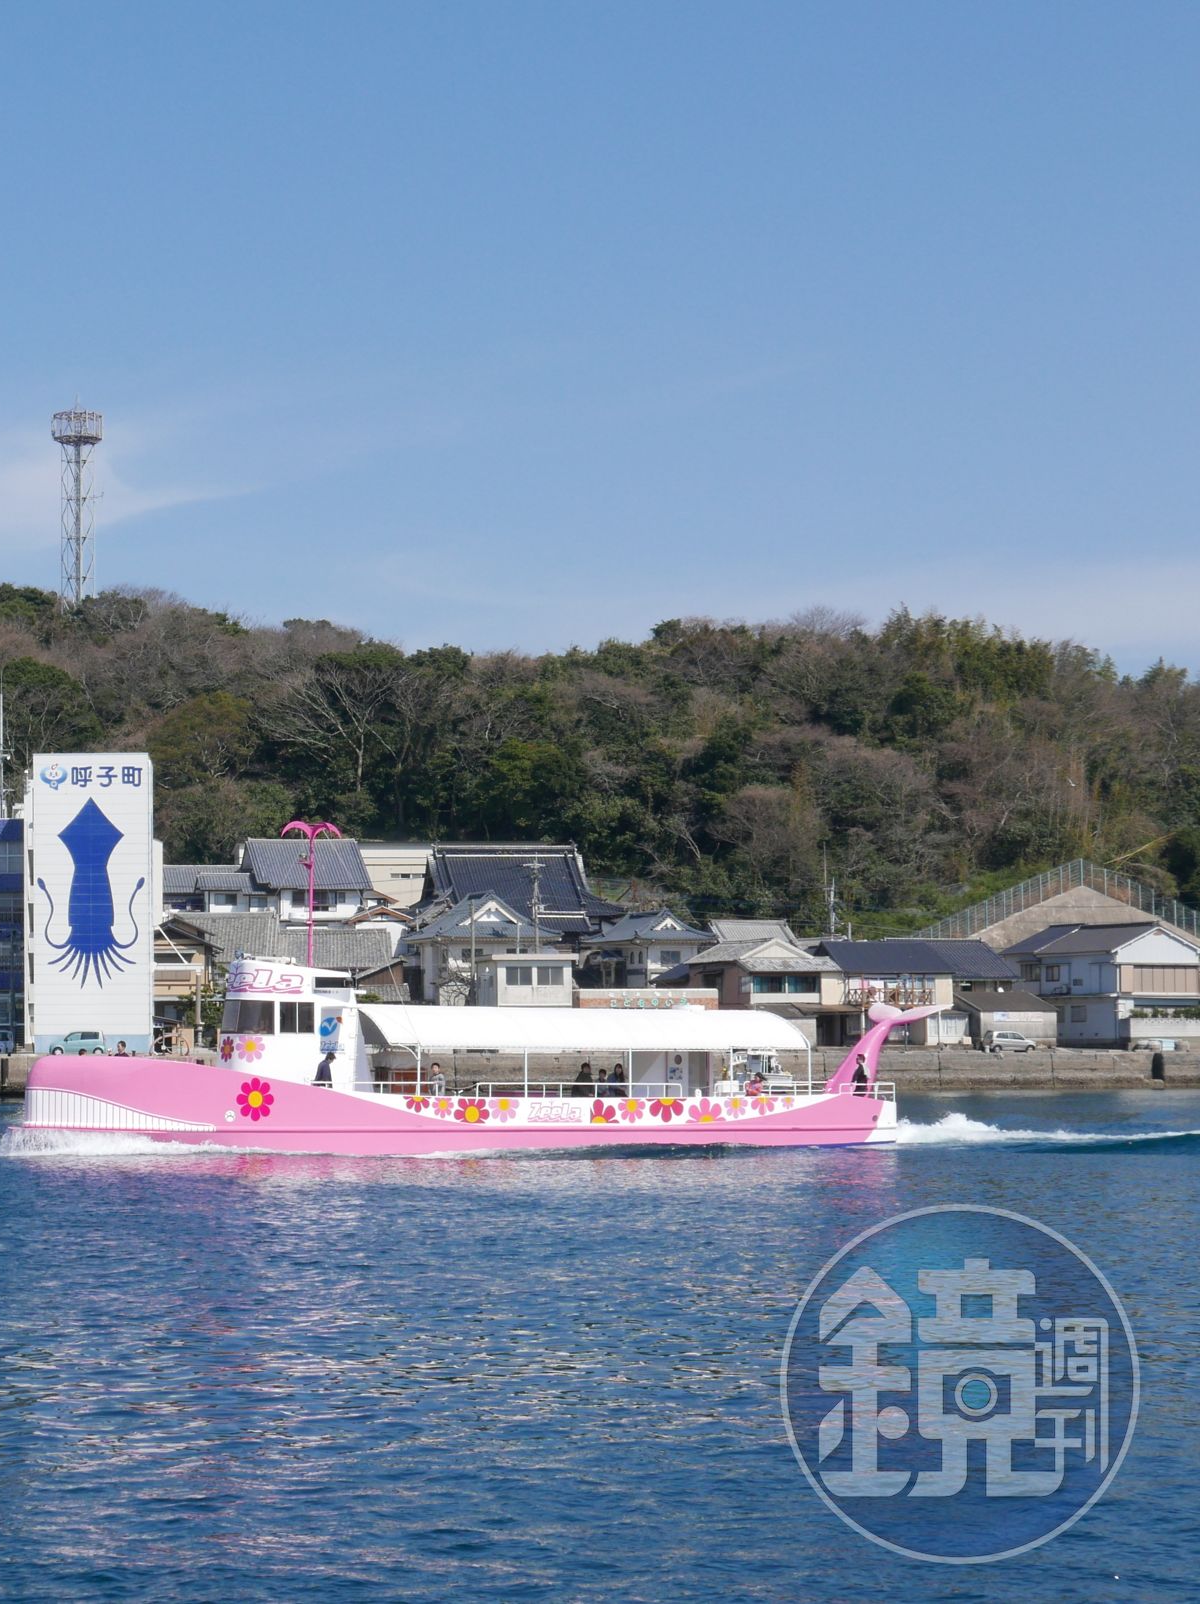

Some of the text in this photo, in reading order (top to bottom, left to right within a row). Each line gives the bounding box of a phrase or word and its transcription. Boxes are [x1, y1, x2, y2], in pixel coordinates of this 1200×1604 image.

[71, 766, 142, 787] 呼子町
[528, 1101, 583, 1123] Zeela
